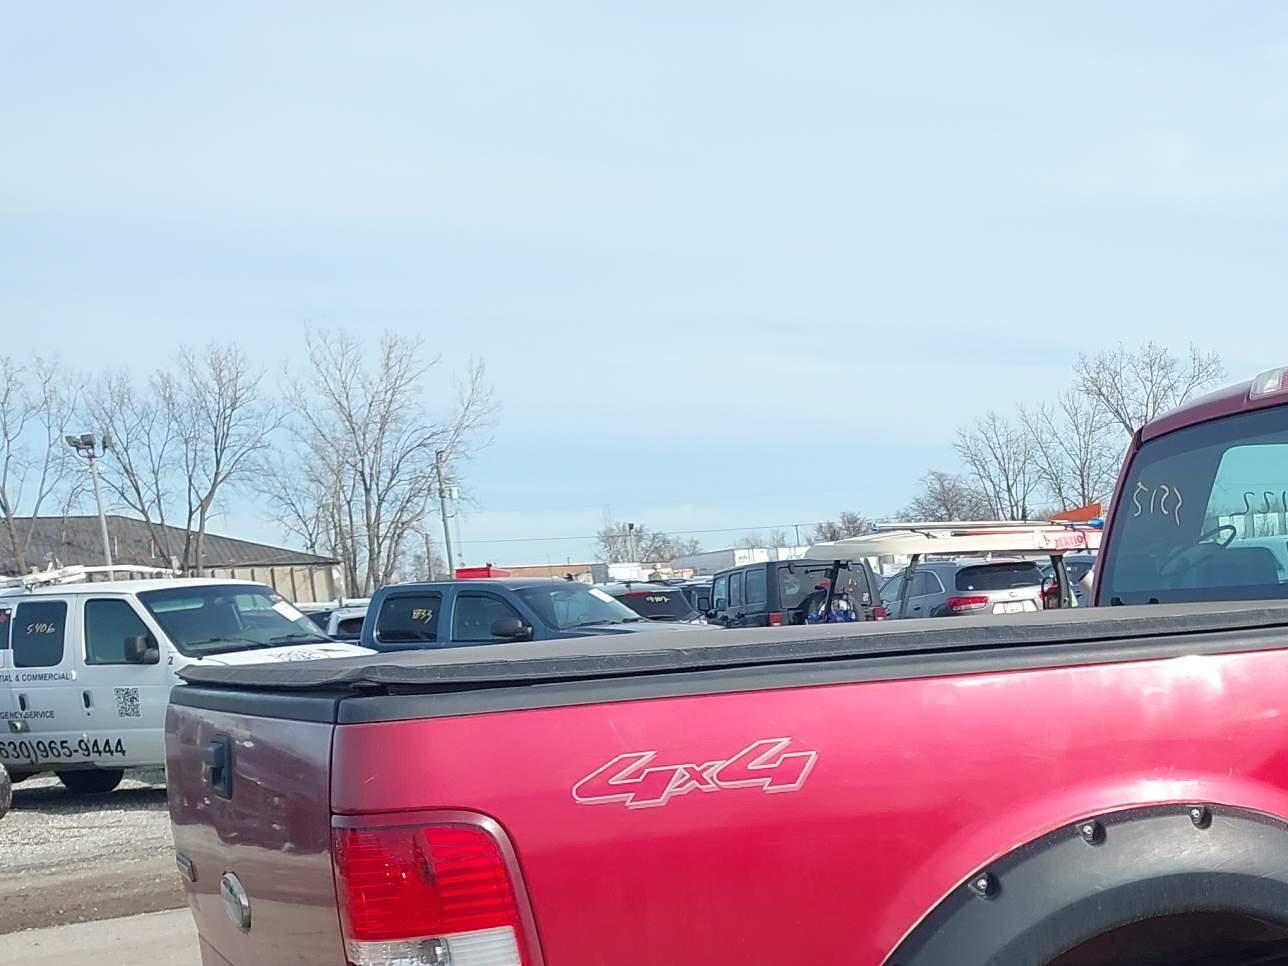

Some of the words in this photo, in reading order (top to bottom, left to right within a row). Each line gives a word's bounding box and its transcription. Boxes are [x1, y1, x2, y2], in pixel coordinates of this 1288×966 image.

[26, 622, 56, 634] 5406
[168, 656, 173, 665] 2
[15, 673, 20, 681] &
[22, 672, 69, 681] COMMERCIAL
[23, 710, 55, 719] SERVICE
[572, 737, 818, 809] 4x4
